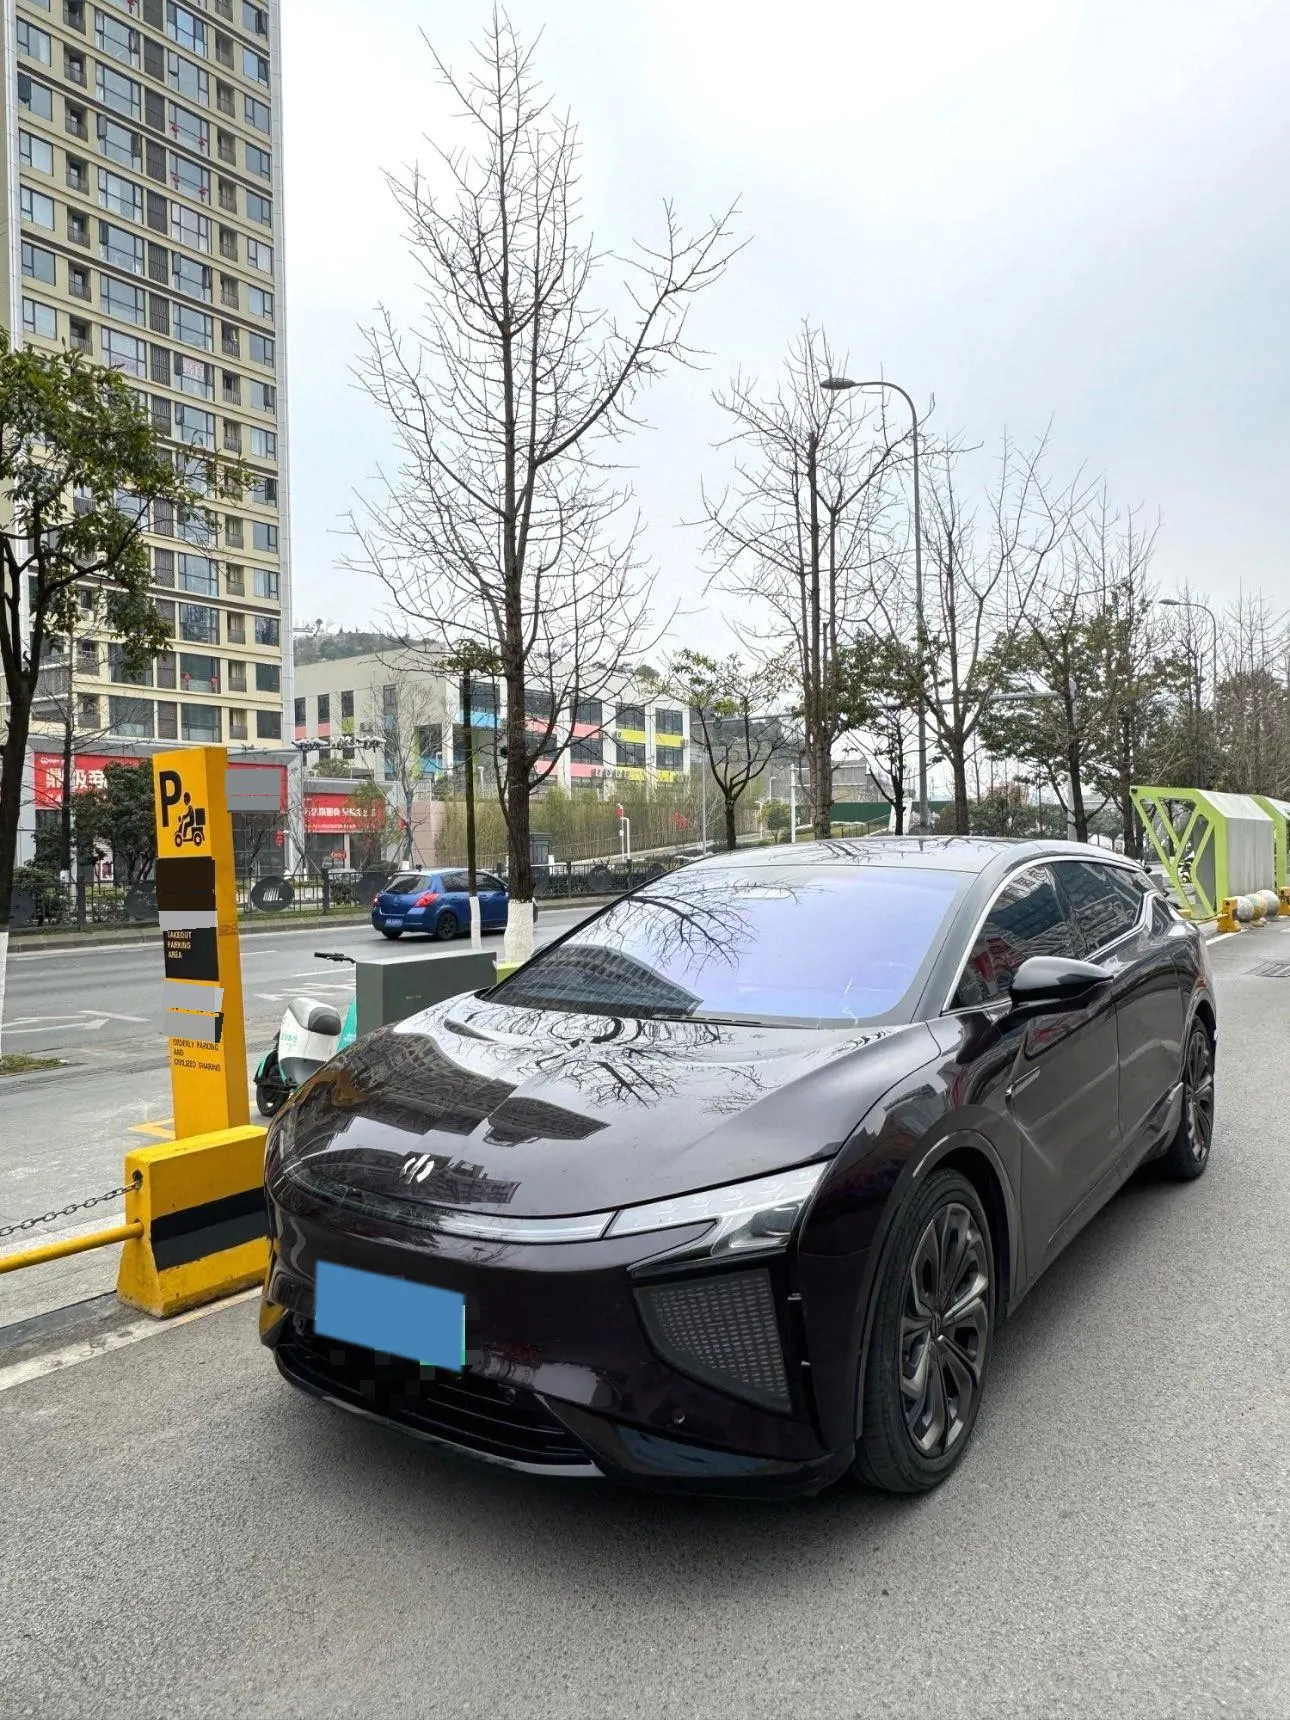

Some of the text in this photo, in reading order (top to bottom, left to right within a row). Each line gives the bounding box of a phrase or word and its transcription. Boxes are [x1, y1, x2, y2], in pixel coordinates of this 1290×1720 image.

[159, 770, 182, 827] P
[168, 941, 191, 949] PARKING
[173, 1039, 218, 1050] ORDERLY PARKING
[173, 1048, 184, 1056] AND
